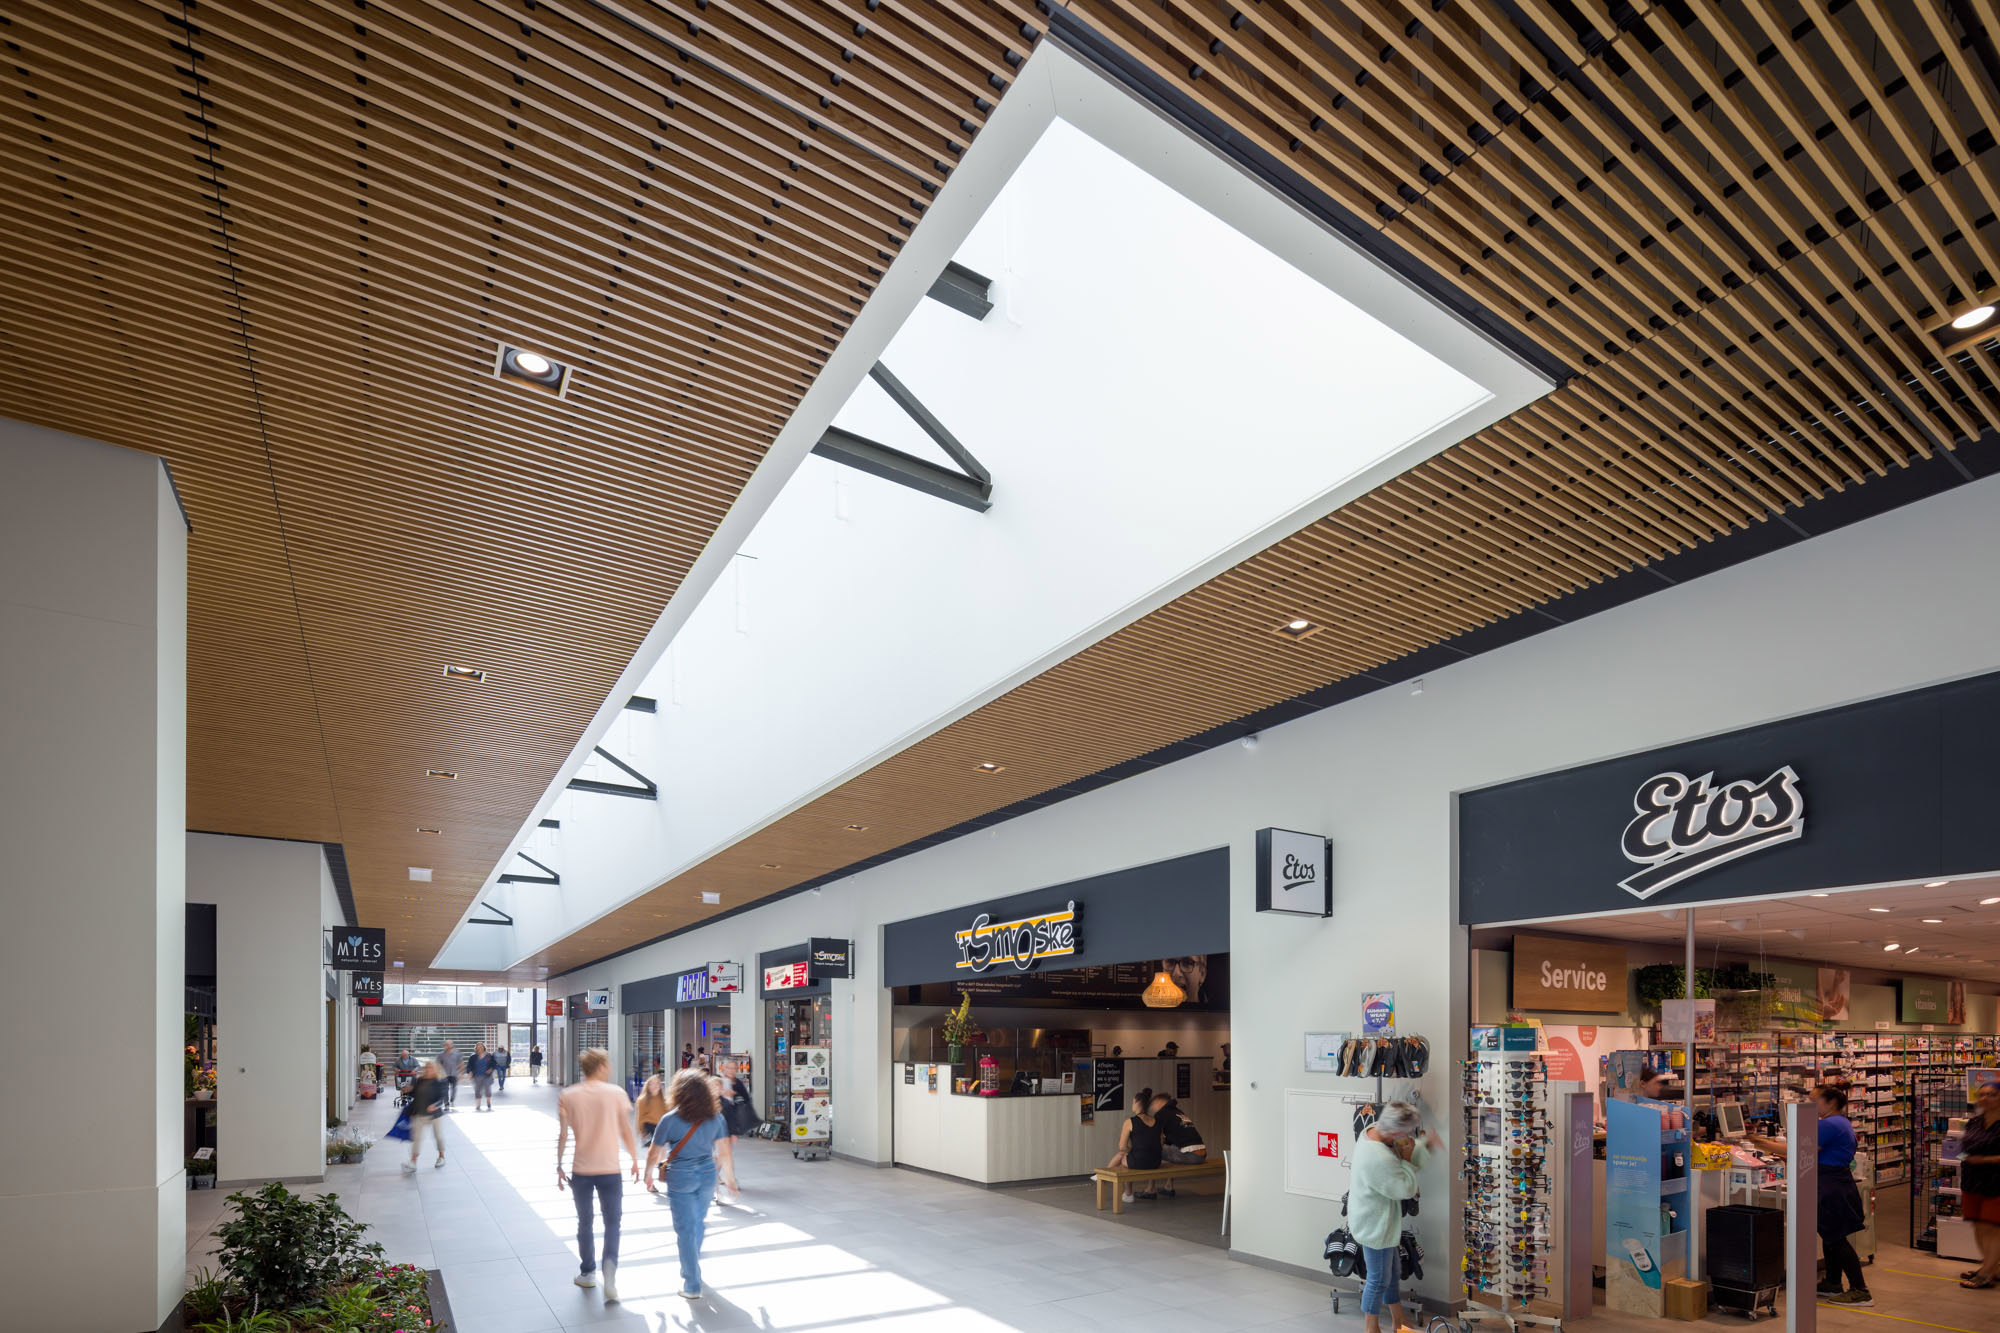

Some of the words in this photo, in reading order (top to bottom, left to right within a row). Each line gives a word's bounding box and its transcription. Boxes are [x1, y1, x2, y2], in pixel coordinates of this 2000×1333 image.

[1621, 765, 1803, 870] Etos
[1282, 853, 1315, 882] Etos
[682, 971, 717, 1001] ACTIO
[1541, 960, 1607, 991] Service
